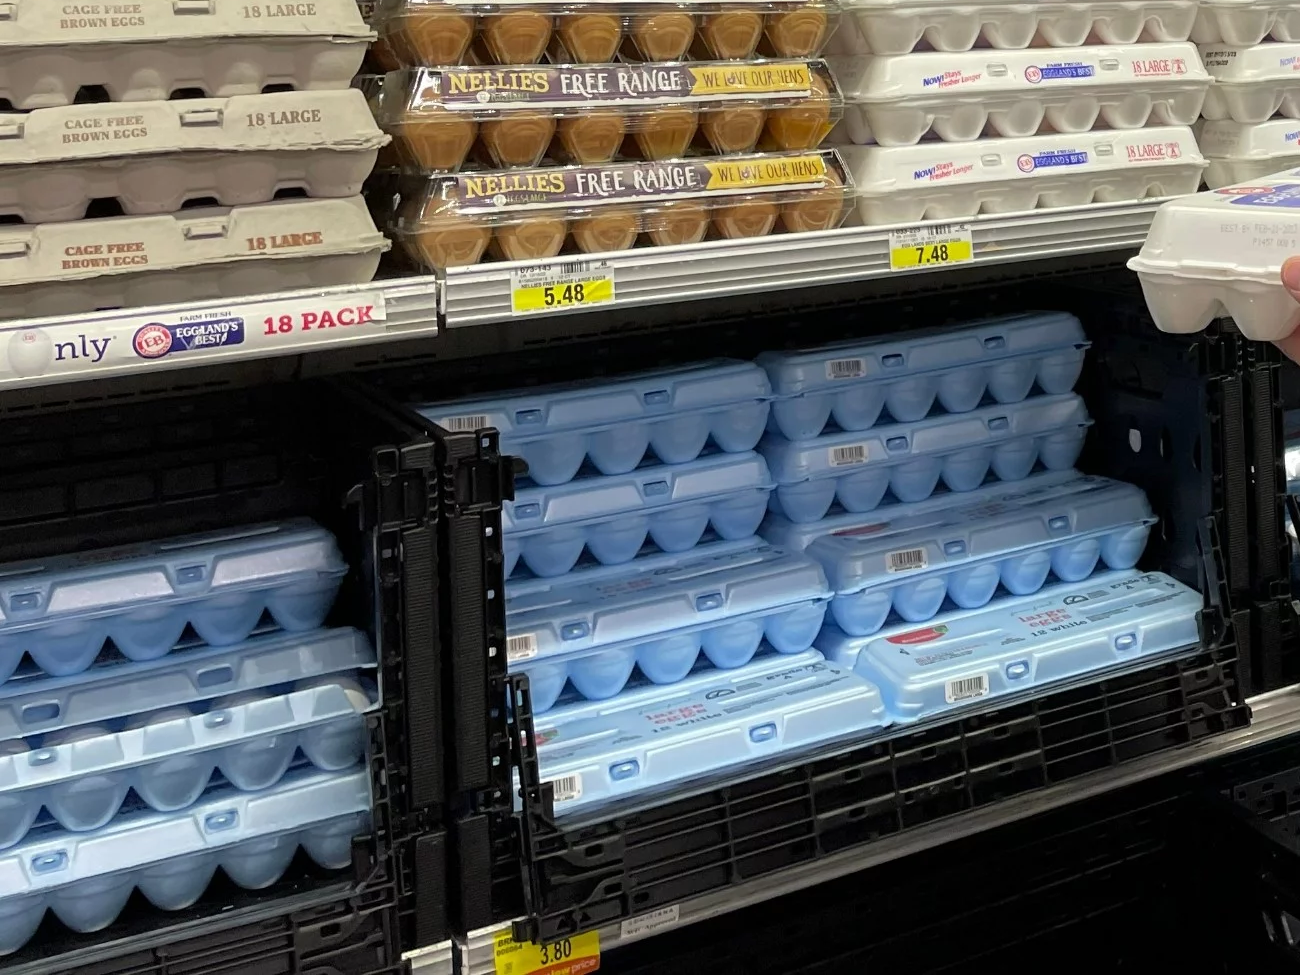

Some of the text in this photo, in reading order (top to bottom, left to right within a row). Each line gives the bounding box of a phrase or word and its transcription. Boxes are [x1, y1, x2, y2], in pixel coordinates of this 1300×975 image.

[62, 4, 142, 16] CAGE FREE
[242, 2, 317, 19] 18 LARGE
[60, 16, 145, 29] BROWN EGGS
[944, 70, 962, 79] Stays
[560, 70, 681, 97] FREE RANGE
[64, 115, 144, 130] CAGE FREE
[719, 169, 735, 182] WE
[765, 163, 789, 178] OUR
[793, 161, 819, 176] HENS
[576, 166, 696, 196] FREE RANGE
[64, 241, 145, 257] CAGE FREE
[916, 245, 949, 263] 7.48
[544, 284, 584, 305] 5.48
[204, 311, 231, 320] FRESH
[263, 306, 374, 335] 18 PACK
[195, 334, 221, 345] BEST
[1050, 620, 1088, 632] white
[540, 937, 572, 965] 3.80
